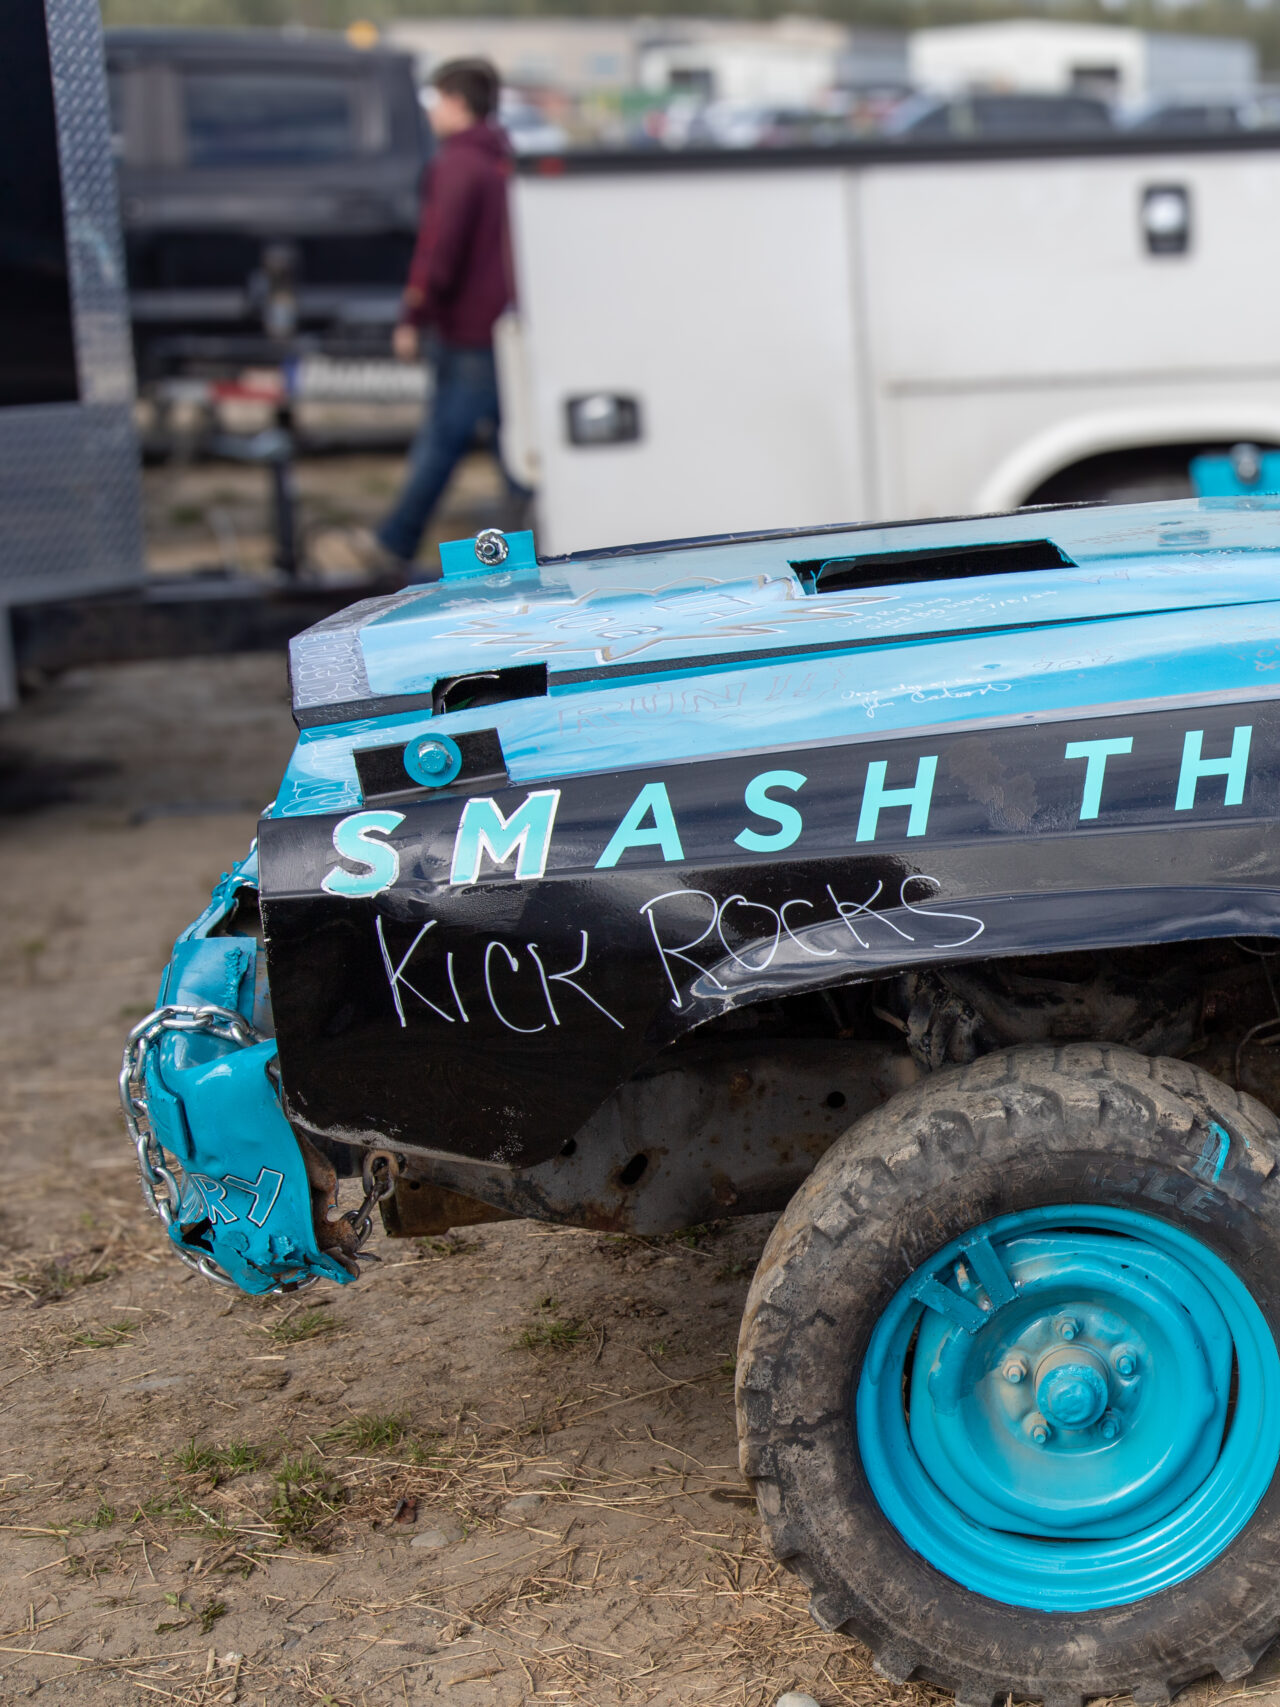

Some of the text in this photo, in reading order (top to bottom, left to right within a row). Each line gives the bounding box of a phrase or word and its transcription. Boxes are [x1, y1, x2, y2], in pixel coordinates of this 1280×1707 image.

[321, 755, 939, 899] SMASH
[375, 874, 986, 1034] KICK ROCKS
